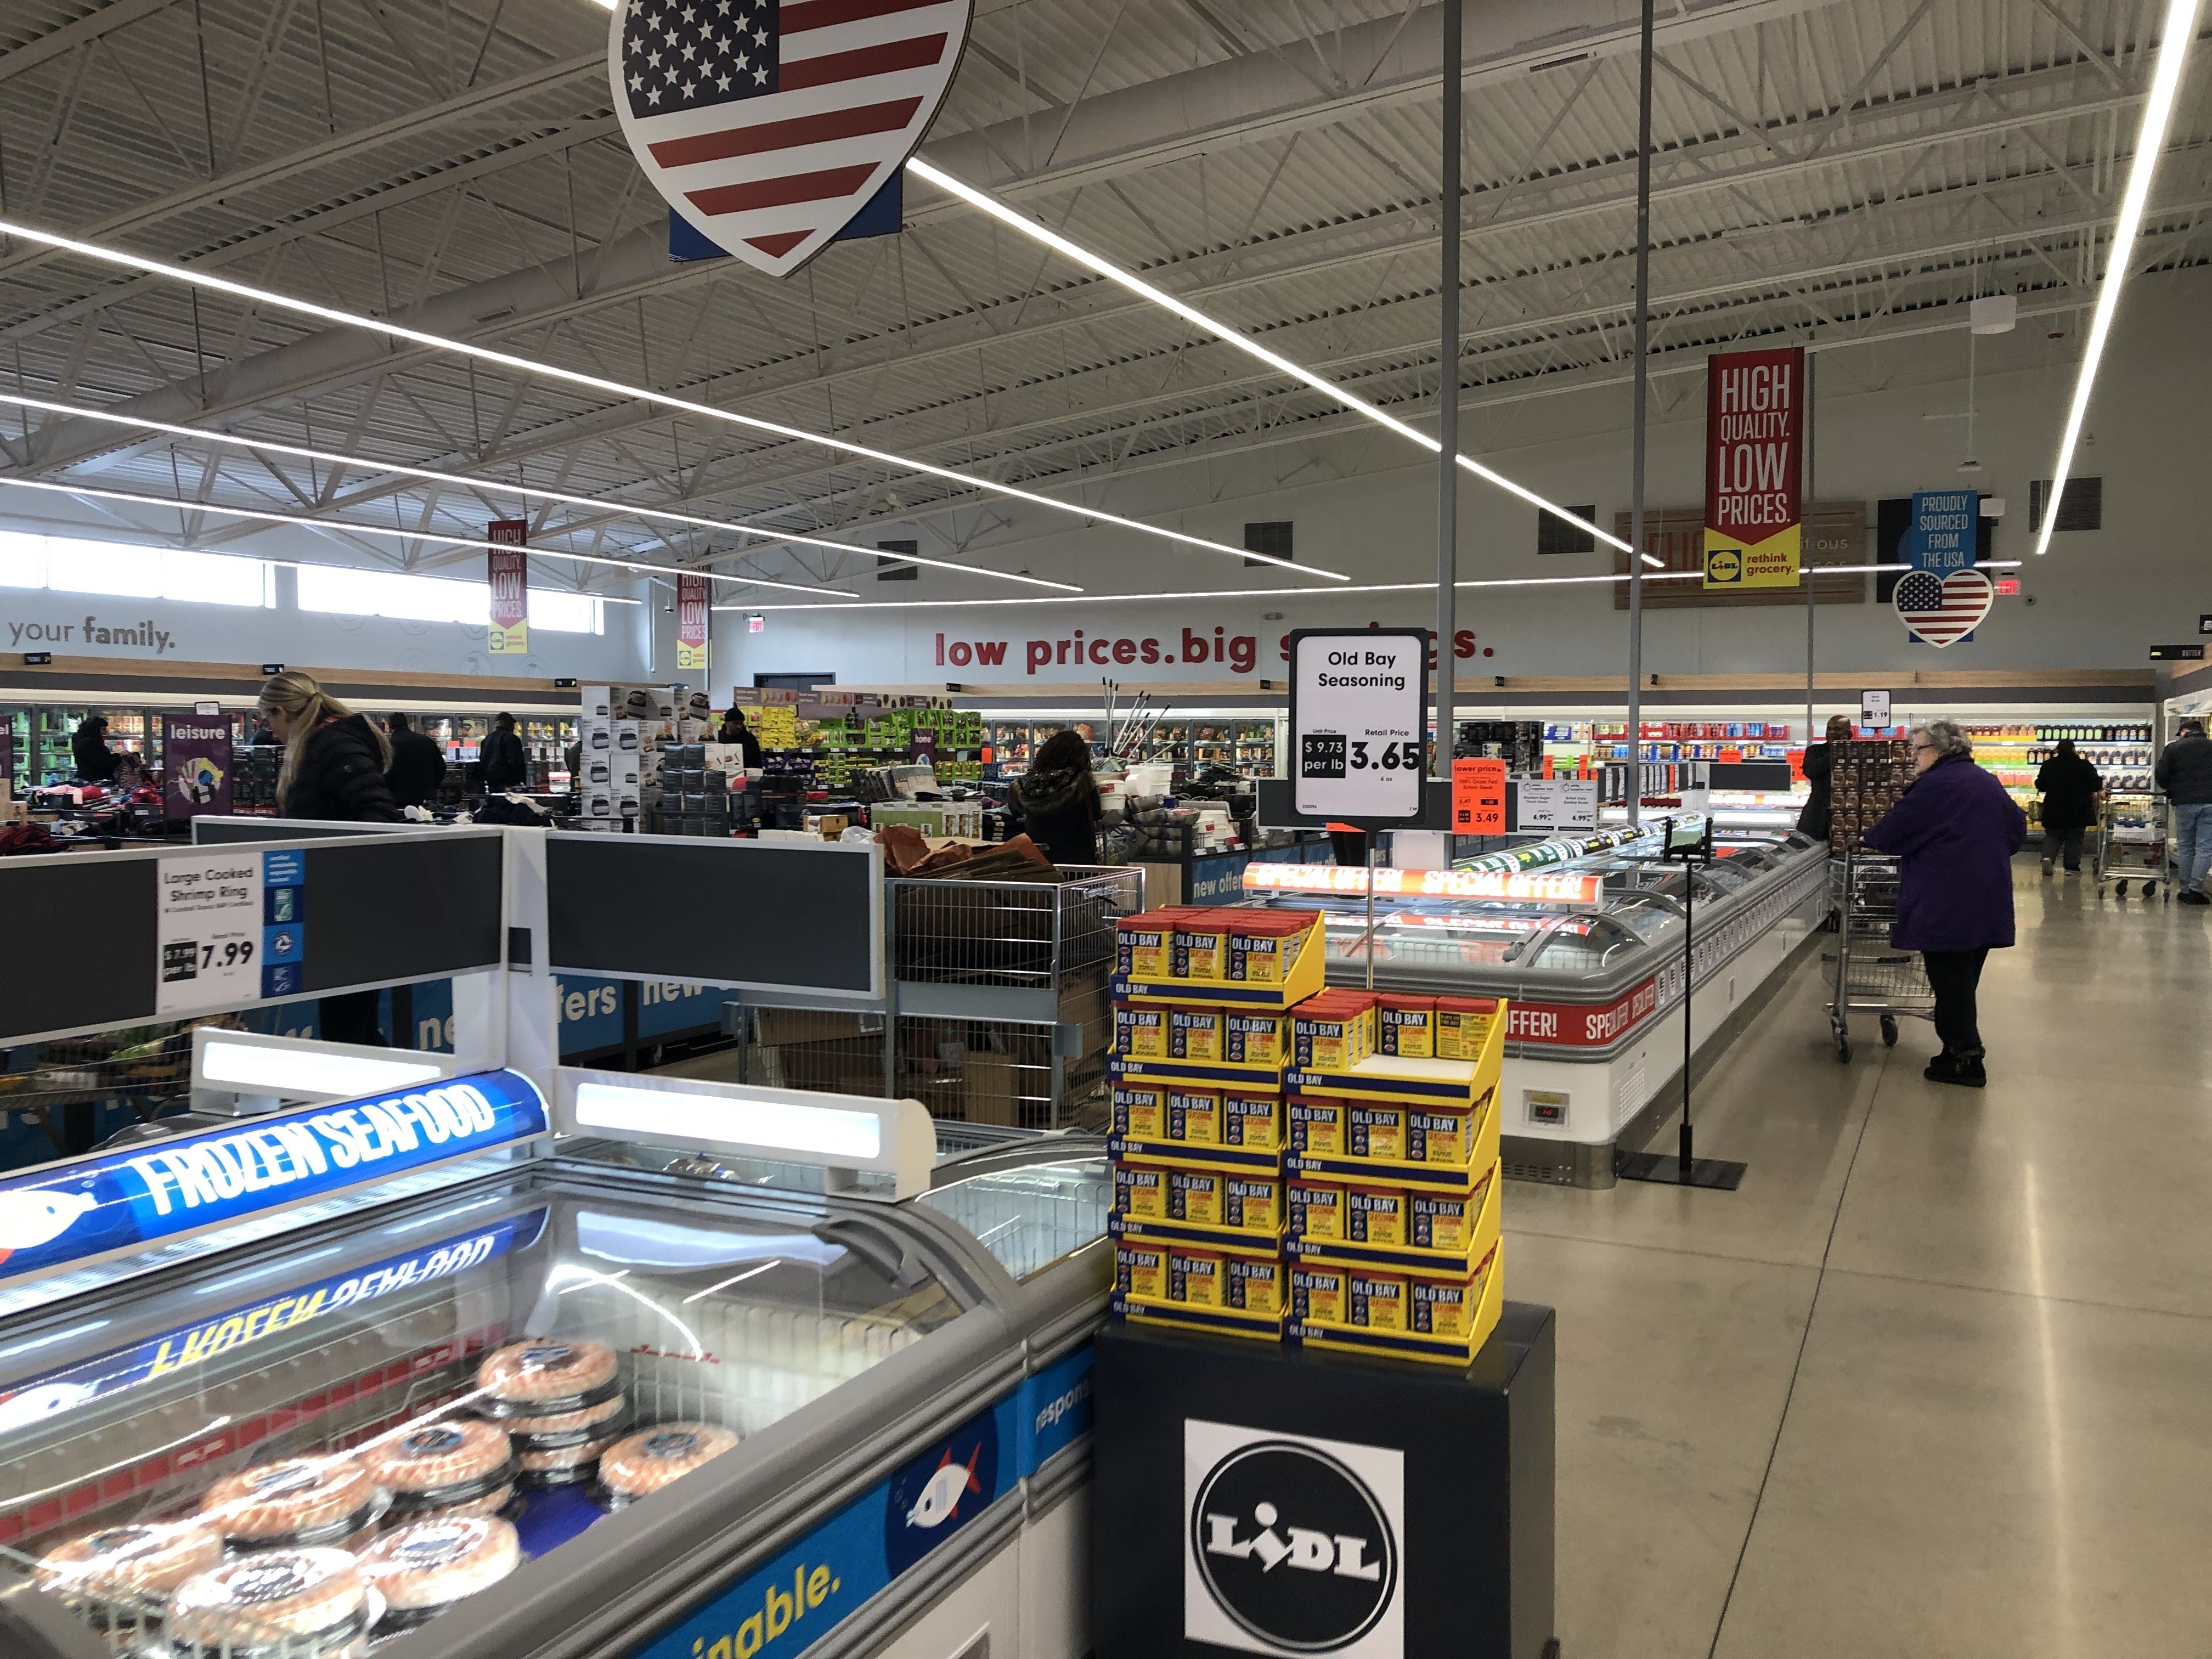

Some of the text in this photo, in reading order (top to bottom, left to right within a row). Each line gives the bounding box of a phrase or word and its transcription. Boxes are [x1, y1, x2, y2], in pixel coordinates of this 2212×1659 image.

[1722, 364, 1791, 413] HIGH
[1720, 411, 1790, 443] QUALITY.
[1719, 442, 1786, 494] LOW
[1718, 493, 1791, 526] PRICES.
[1922, 495, 1968, 512] PROUDLY
[1920, 514, 1968, 531] SOURCED
[1928, 533, 1959, 549] FROM
[1746, 553, 1787, 563] rethink
[1922, 551, 1965, 568] THE USA
[493, 572, 521, 600] LOW
[681, 601, 706, 624] LOW
[8, 616, 176, 654] your family.
[935, 633, 1008, 666] low
[1328, 651, 1397, 669] Old Bay
[1318, 673, 1406, 692] Seasoning
[170, 724, 226, 740] leisure
[914, 735, 932, 744] home
[1305, 741, 1344, 754] $ 9.73
[1350, 741, 1420, 770] 3.65
[1304, 758, 1344, 772] per lb
[1475, 812, 1499, 823] 3.49
[164, 872, 201, 886] Large
[205, 866, 253, 881] Cooked
[1193, 871, 1244, 899] new offer
[1421, 870, 1583, 900] SPECIAL OFFER!
[170, 885, 247, 902] Shrimp Ring
[1119, 933, 1159, 947] OLD BAY
[1176, 934, 1215, 949] OLD BAY
[1232, 938, 1273, 952] OLD BAY
[201, 941, 254, 969] 7.99
[1115, 983, 1148, 994] OLD BAY
[556, 984, 617, 1024] fers
[1118, 1012, 1158, 1026] OLD BAY
[1173, 1013, 1212, 1029] OLD BAY
[1229, 1018, 1273, 1032] OLD BAY
[1383, 1011, 1425, 1025] OLD BAY
[419, 1015, 454, 1051] ne
[1296, 1022, 1340, 1037] OLD BAY
[1110, 1062, 1143, 1073] OLD BAY
[1288, 1073, 1322, 1085] OLD BAY
[1115, 1091, 1154, 1105] OLD BAY
[1171, 1096, 1211, 1110] OLD BAY
[1228, 1101, 1270, 1116] OLD BAY
[1291, 1107, 1334, 1122] OLD BAY
[1352, 1110, 1396, 1126] OLD BAY
[1410, 1115, 1455, 1132] OLD BAY
[127, 1083, 496, 1216] FROZEN SEAFOOD
[1287, 1158, 1322, 1171] OLD BAY
[1116, 1171, 1156, 1186] OLD BAY
[1172, 1175, 1212, 1191] OLD BAY
[1228, 1182, 1269, 1198] OLD BAY
[1290, 1189, 1334, 1205] OLD BAY
[1351, 1195, 1396, 1212] OLD BAY
[1415, 1200, 1461, 1216] OLD BAY
[1172, 1257, 1213, 1276] OLD BAY
